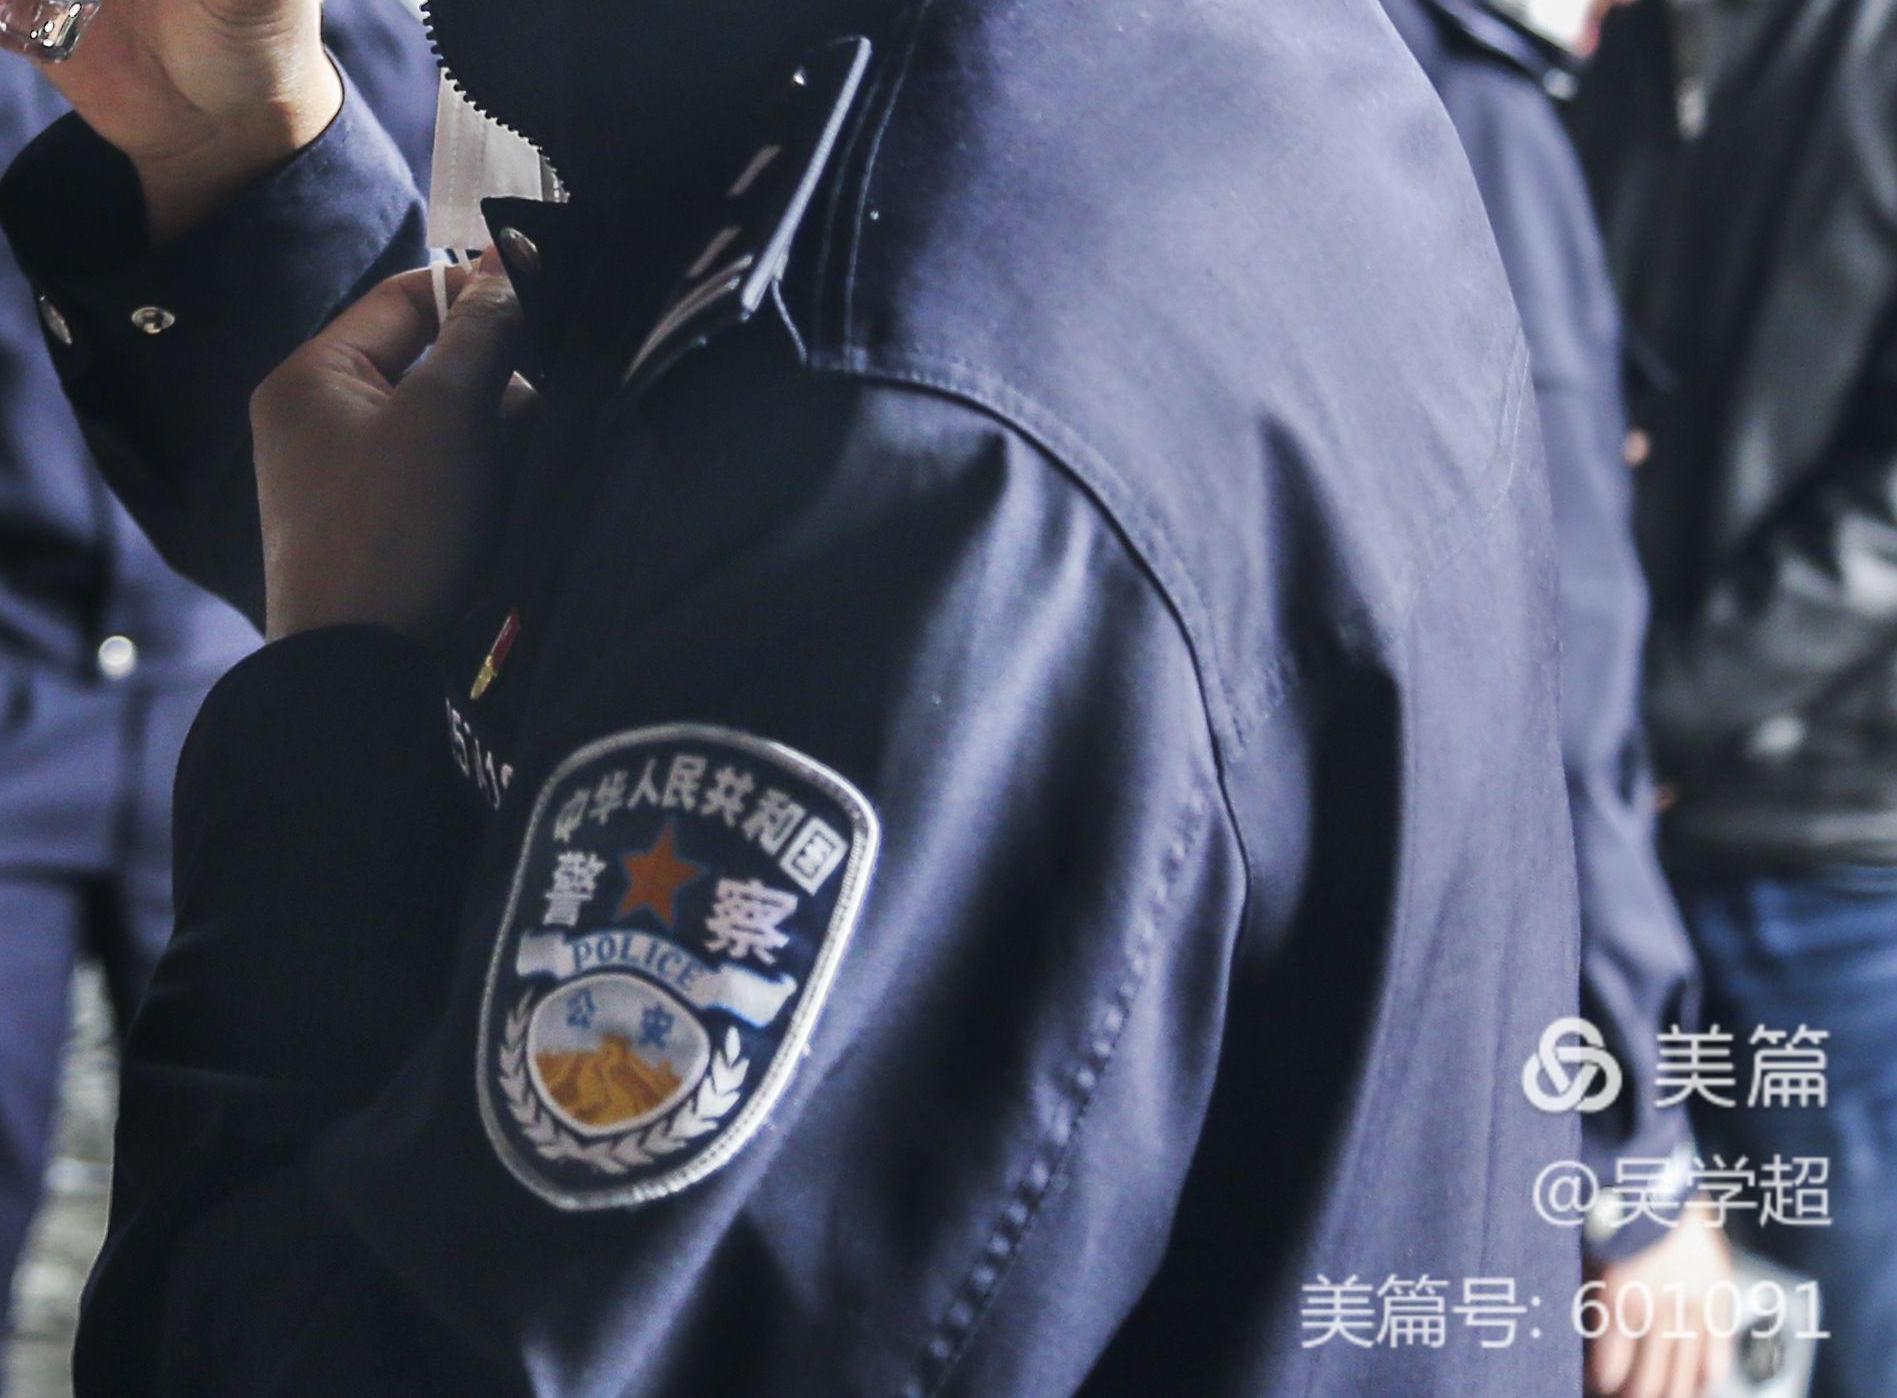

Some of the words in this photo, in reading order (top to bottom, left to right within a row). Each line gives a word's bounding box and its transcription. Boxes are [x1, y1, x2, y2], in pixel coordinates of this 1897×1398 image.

[552, 754, 849, 897] 中华人民共和国
[570, 934, 701, 994] POLICE
